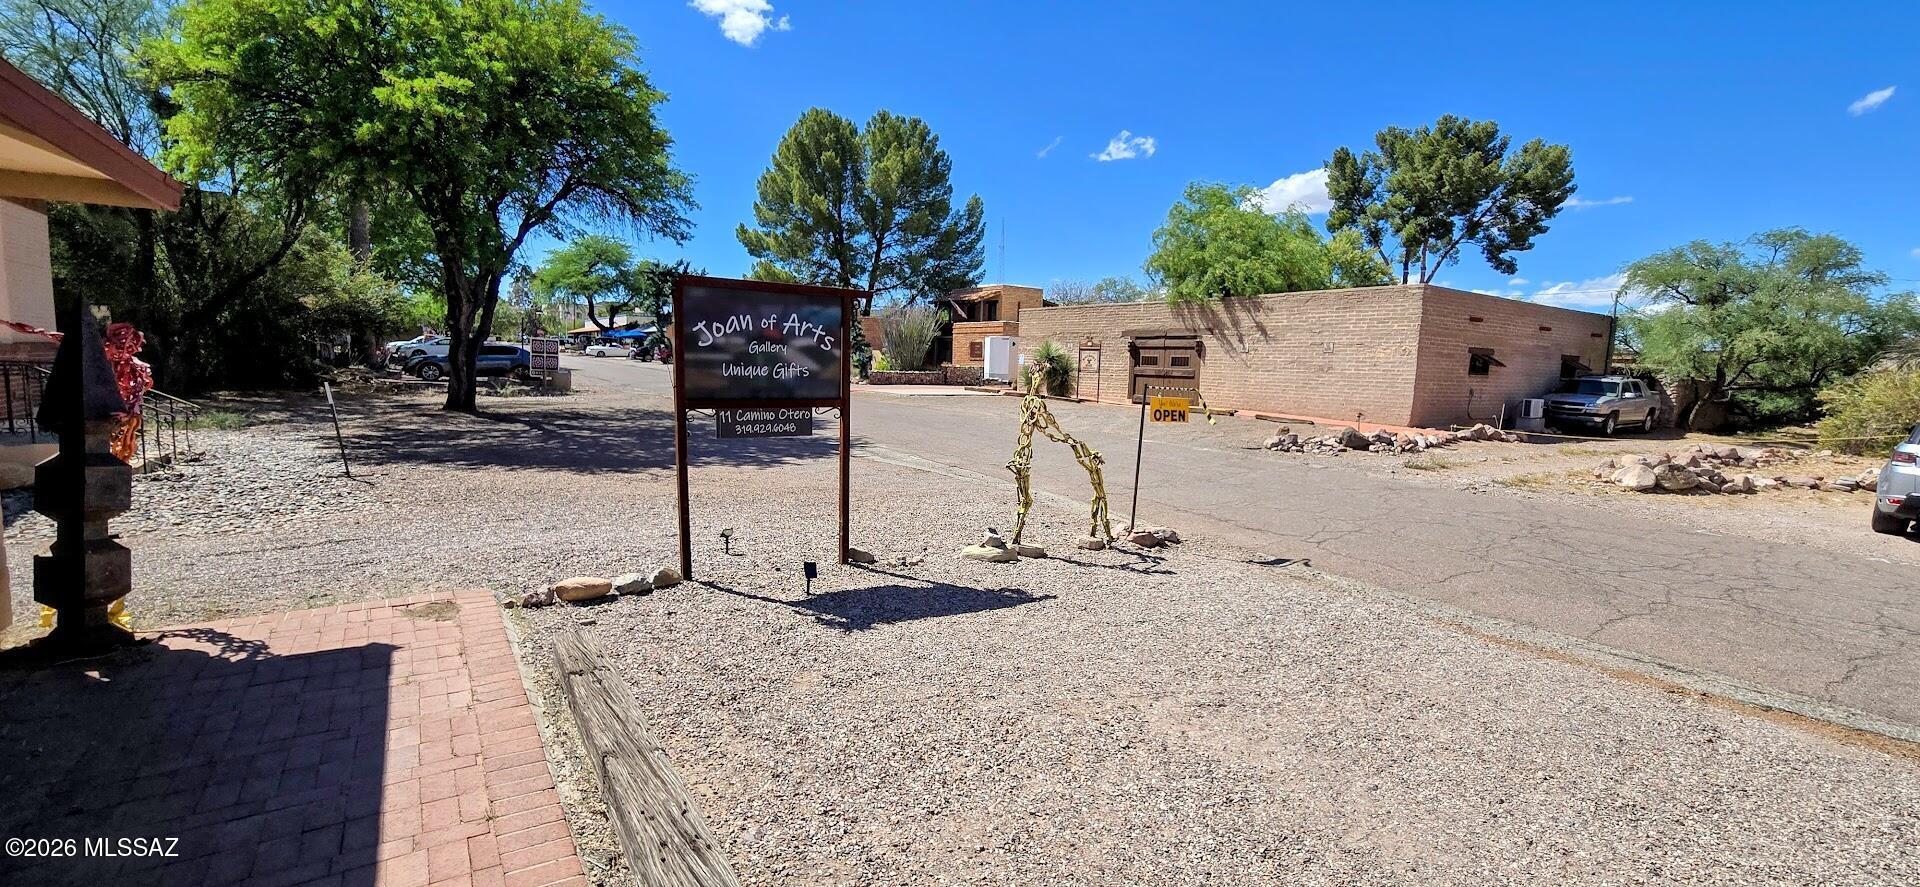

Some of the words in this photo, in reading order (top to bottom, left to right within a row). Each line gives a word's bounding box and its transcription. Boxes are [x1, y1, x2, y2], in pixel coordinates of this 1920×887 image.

[692, 314, 753, 347] Joan
[761, 314, 777, 331] of
[783, 313, 835, 351] Arts
[748, 341, 788, 355] Gallery
[722, 362, 769, 379] Unique
[772, 362, 810, 380] Gifts
[720, 410, 732, 423] 11
[736, 409, 775, 421] Camino
[778, 408, 810, 420] Otero
[1153, 409, 1186, 422] OPEN
[735, 422, 797, 435] 319.929.6048
